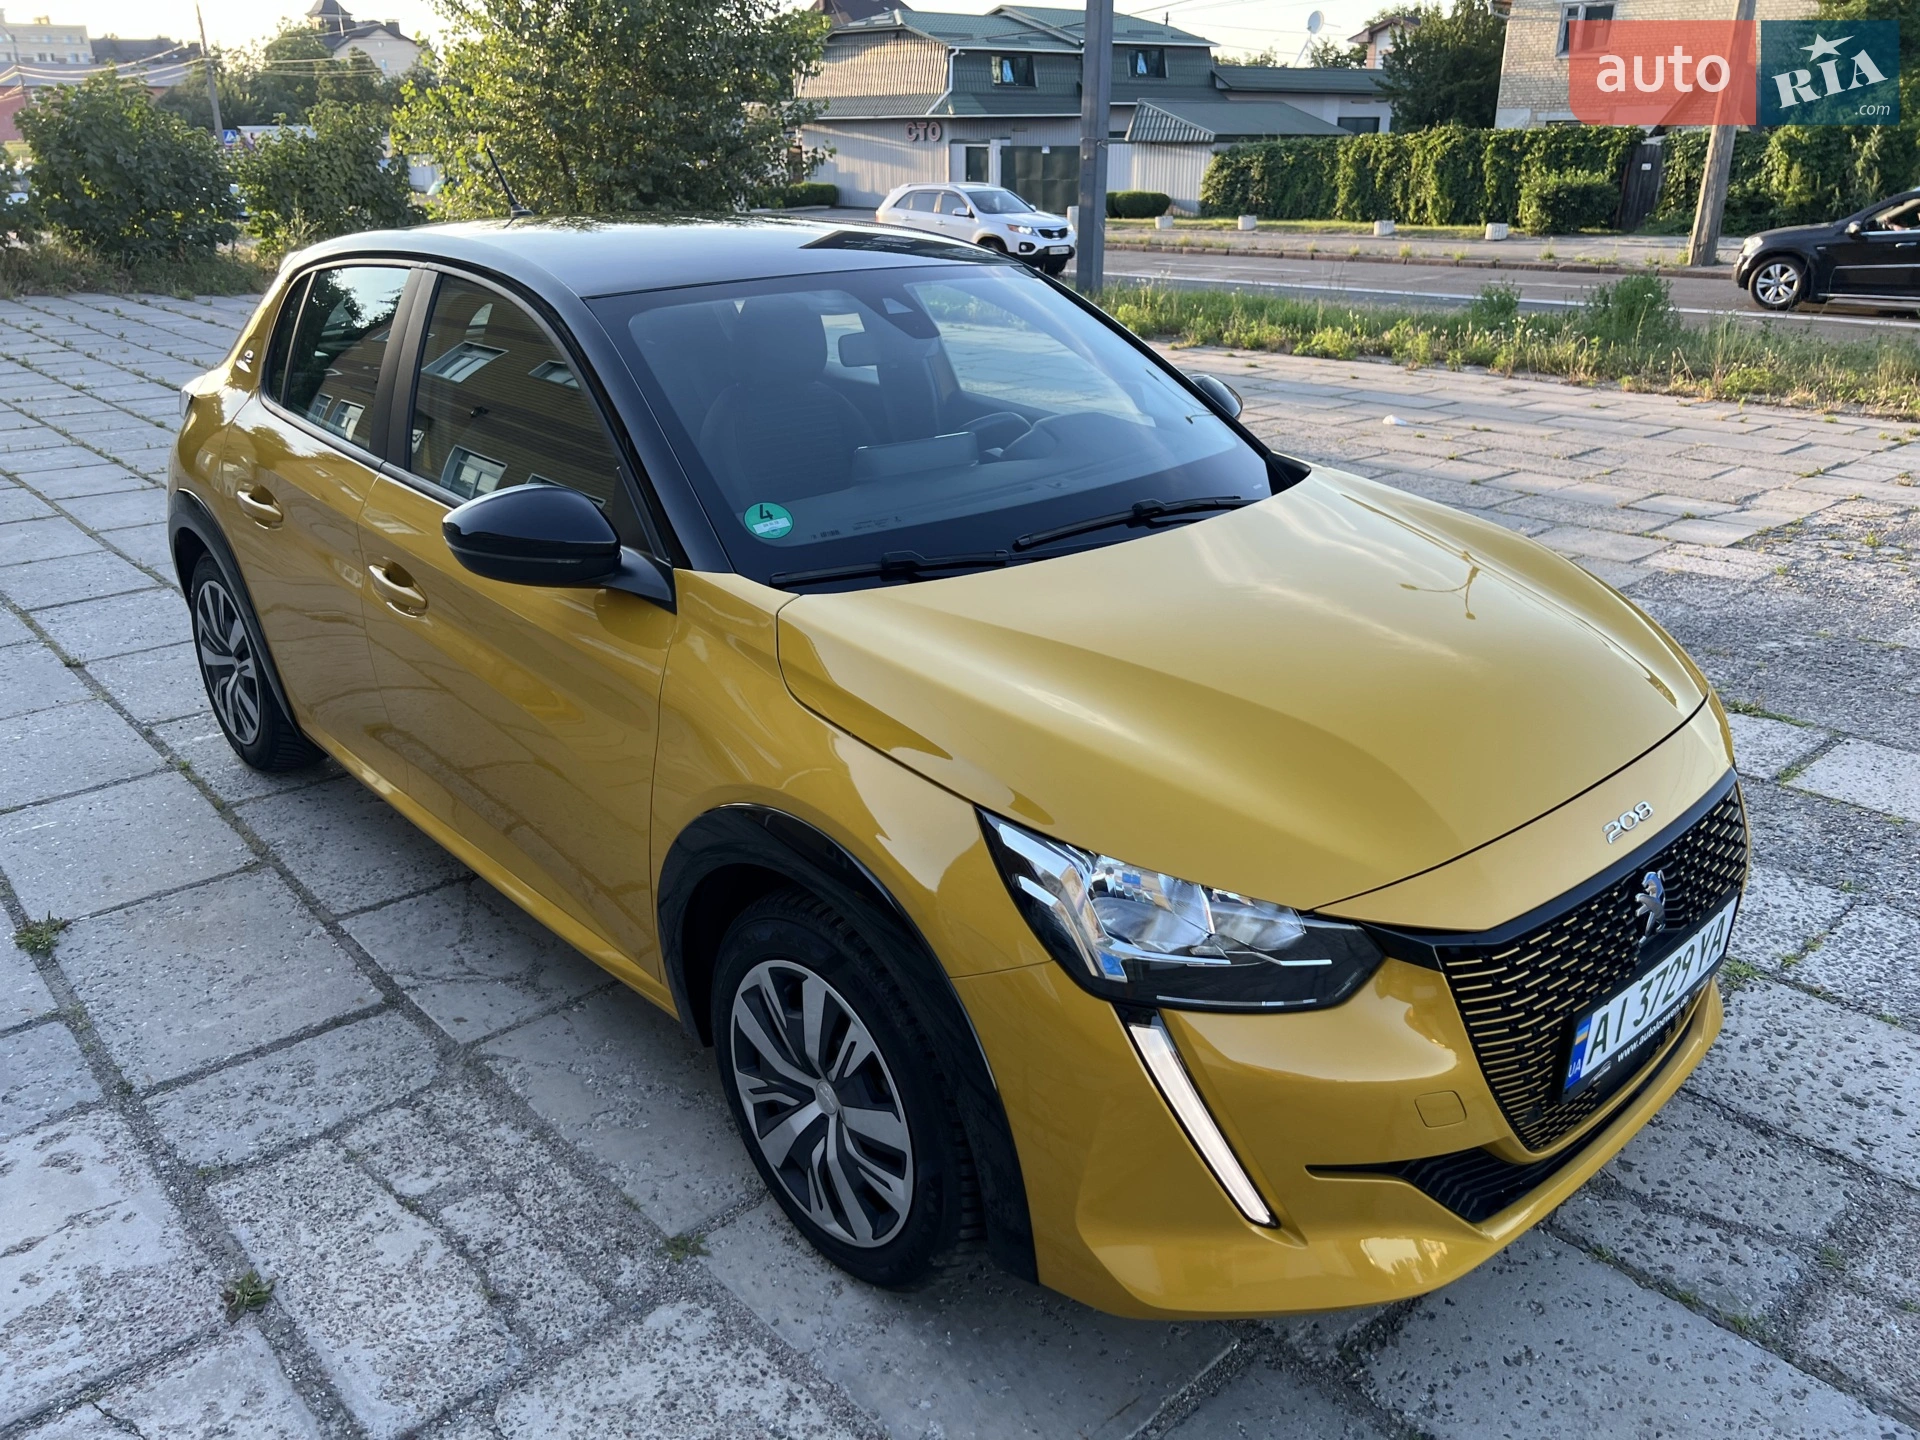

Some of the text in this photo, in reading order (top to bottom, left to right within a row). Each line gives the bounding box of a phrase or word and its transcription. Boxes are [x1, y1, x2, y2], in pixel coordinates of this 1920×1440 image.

[905, 121, 942, 142] СТО
[759, 504, 774, 520] 4
[1602, 801, 1653, 844] 208
[1633, 943, 1695, 1028] 3729
[1568, 1058, 1581, 1078] UA
